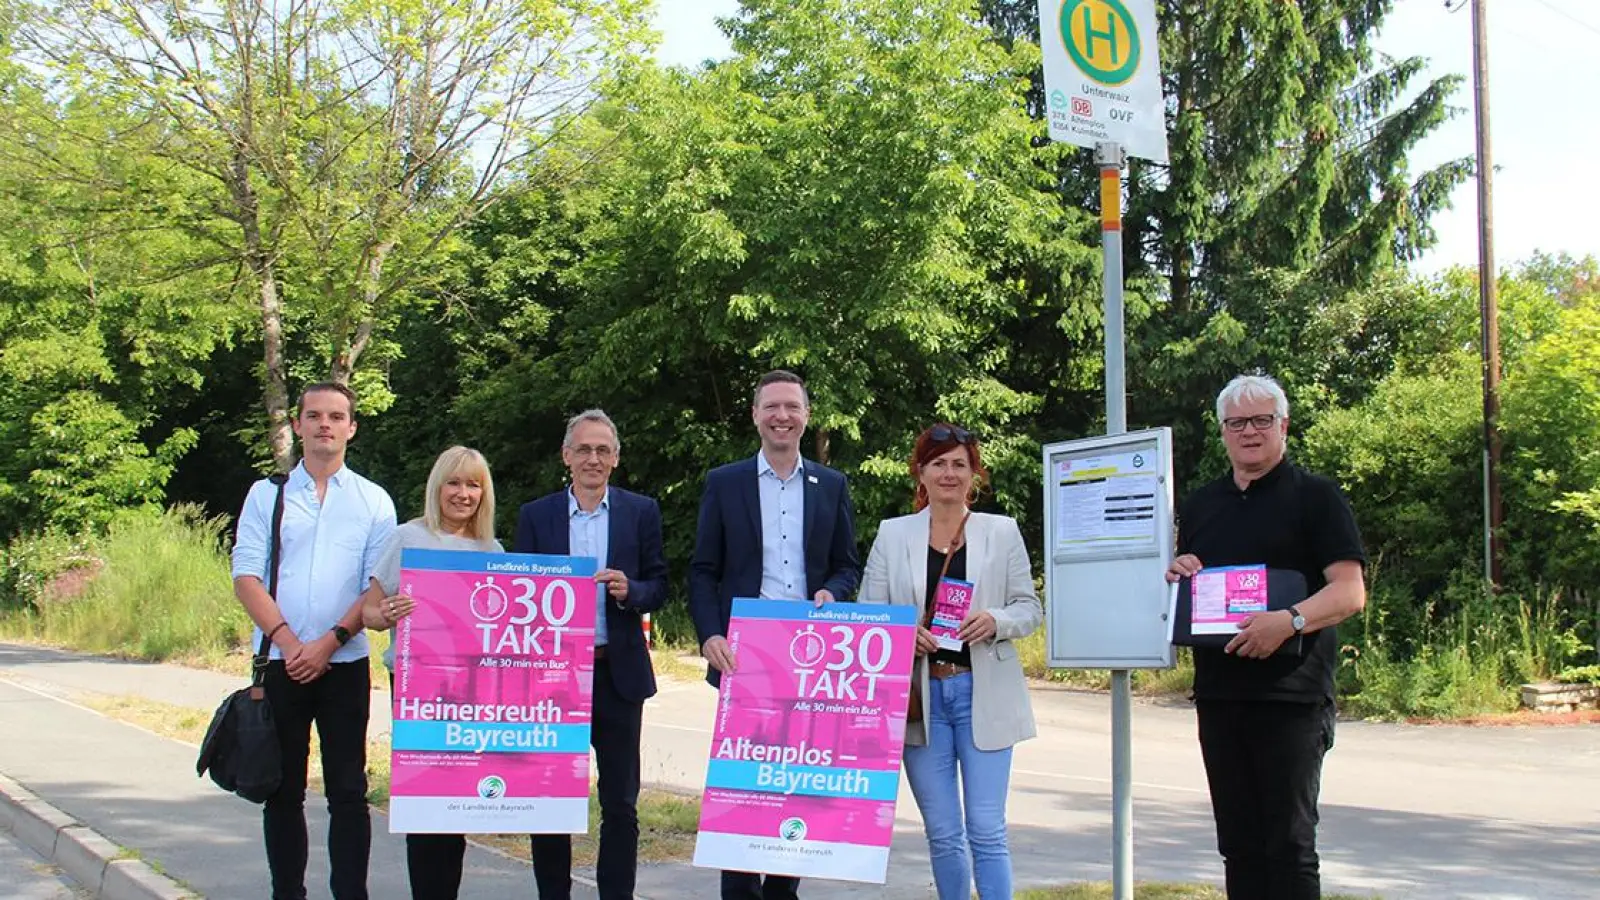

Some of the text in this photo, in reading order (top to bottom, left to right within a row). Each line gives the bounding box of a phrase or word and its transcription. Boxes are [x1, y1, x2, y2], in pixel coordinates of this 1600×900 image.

[1084, 6, 1118, 64] H
[1082, 84, 1130, 103] Unterwaiz
[1073, 100, 1090, 115] DB
[1110, 108, 1134, 122] OVF
[487, 561, 573, 575] Landkreis Bayreuth
[509, 577, 576, 627] 30
[808, 610, 891, 624] Landkreis Bayreuth
[476, 623, 570, 656] TAKT
[825, 625, 892, 673] 30
[479, 658, 497, 667] Alle
[499, 658, 512, 667] 30
[513, 659, 531, 668] min
[533, 660, 548, 668] ein
[793, 669, 885, 701] TAKT
[399, 697, 561, 723] Heinersreuth
[793, 703, 810, 711] Alle
[812, 703, 824, 712] 30
[825, 704, 844, 713] min
[845, 706, 860, 714] ein
[446, 723, 558, 753] Bayreuth
[716, 737, 832, 766] Altenplos
[757, 765, 869, 795] Bayreuth
[462, 803, 498, 811] Landkreis
[500, 804, 535, 812] Bayreuth
[800, 846, 833, 856] Bayreuth
